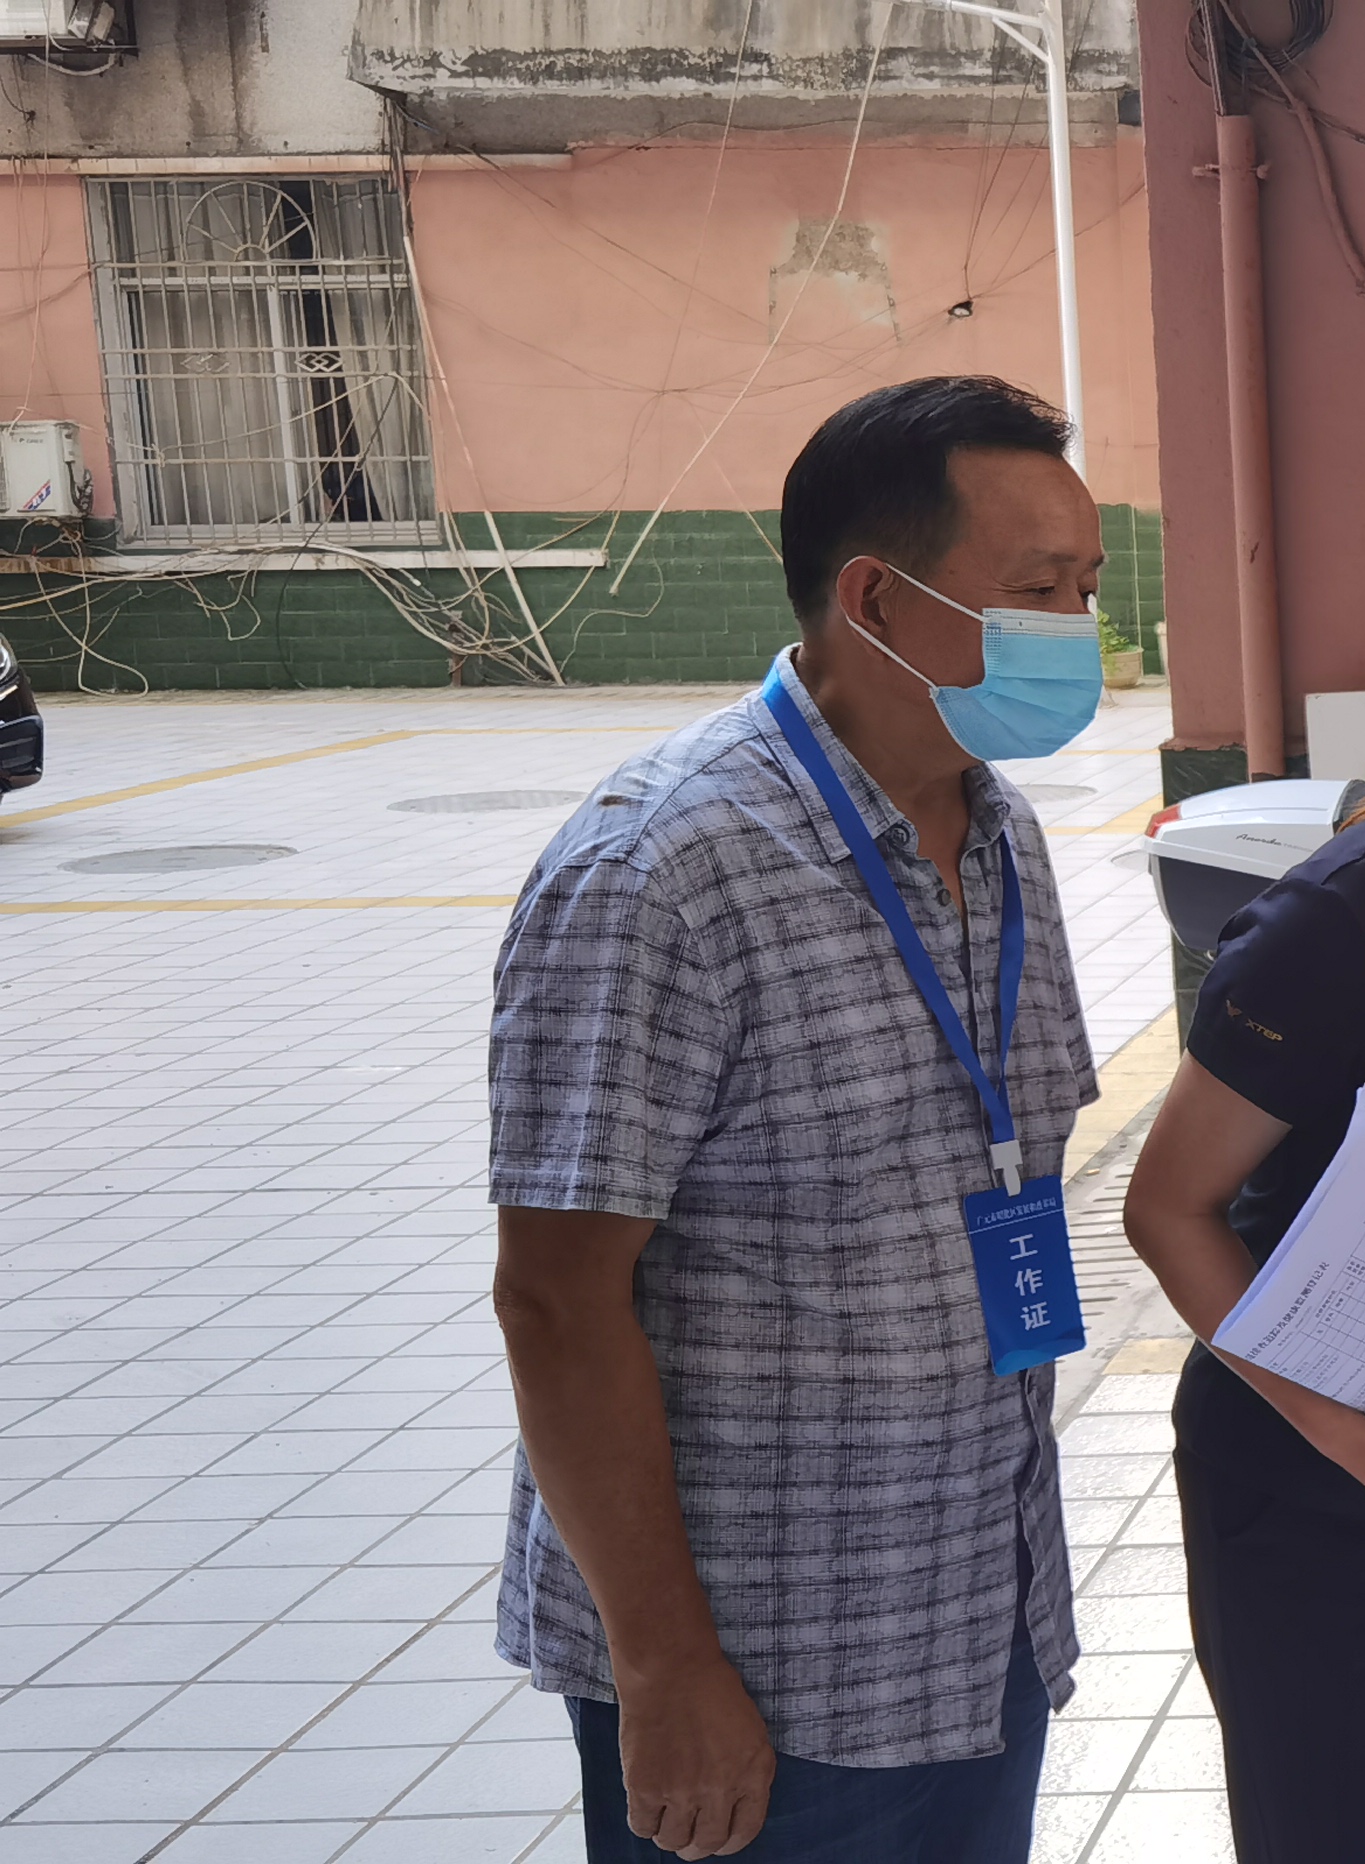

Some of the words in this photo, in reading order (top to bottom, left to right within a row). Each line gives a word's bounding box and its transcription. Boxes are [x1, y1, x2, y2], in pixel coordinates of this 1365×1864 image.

[1245, 1018, 1284, 1041] XTEP
[1008, 1233, 1051, 1332] 工作证
